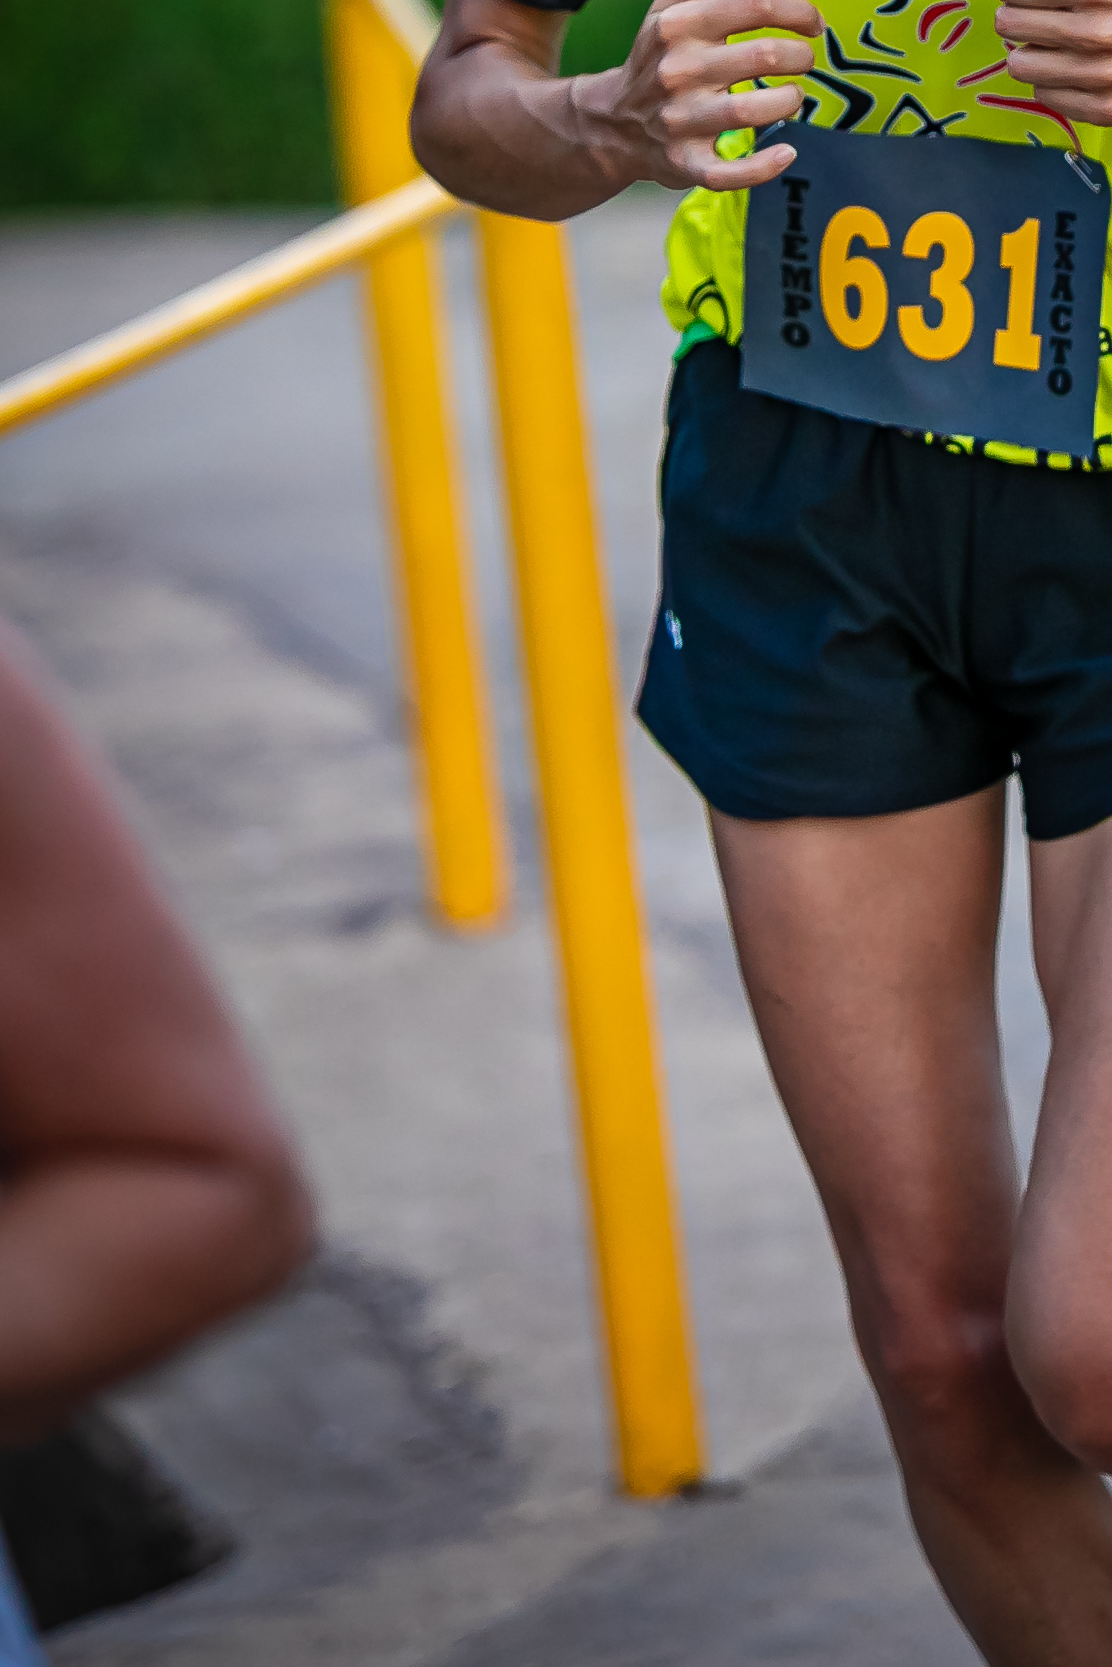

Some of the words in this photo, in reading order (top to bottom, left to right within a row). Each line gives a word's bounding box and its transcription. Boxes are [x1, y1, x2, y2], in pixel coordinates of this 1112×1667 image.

[781, 176, 811, 348] TIEMPO
[818, 205, 1042, 373] 631
[1048, 210, 1076, 405] EXACTO
